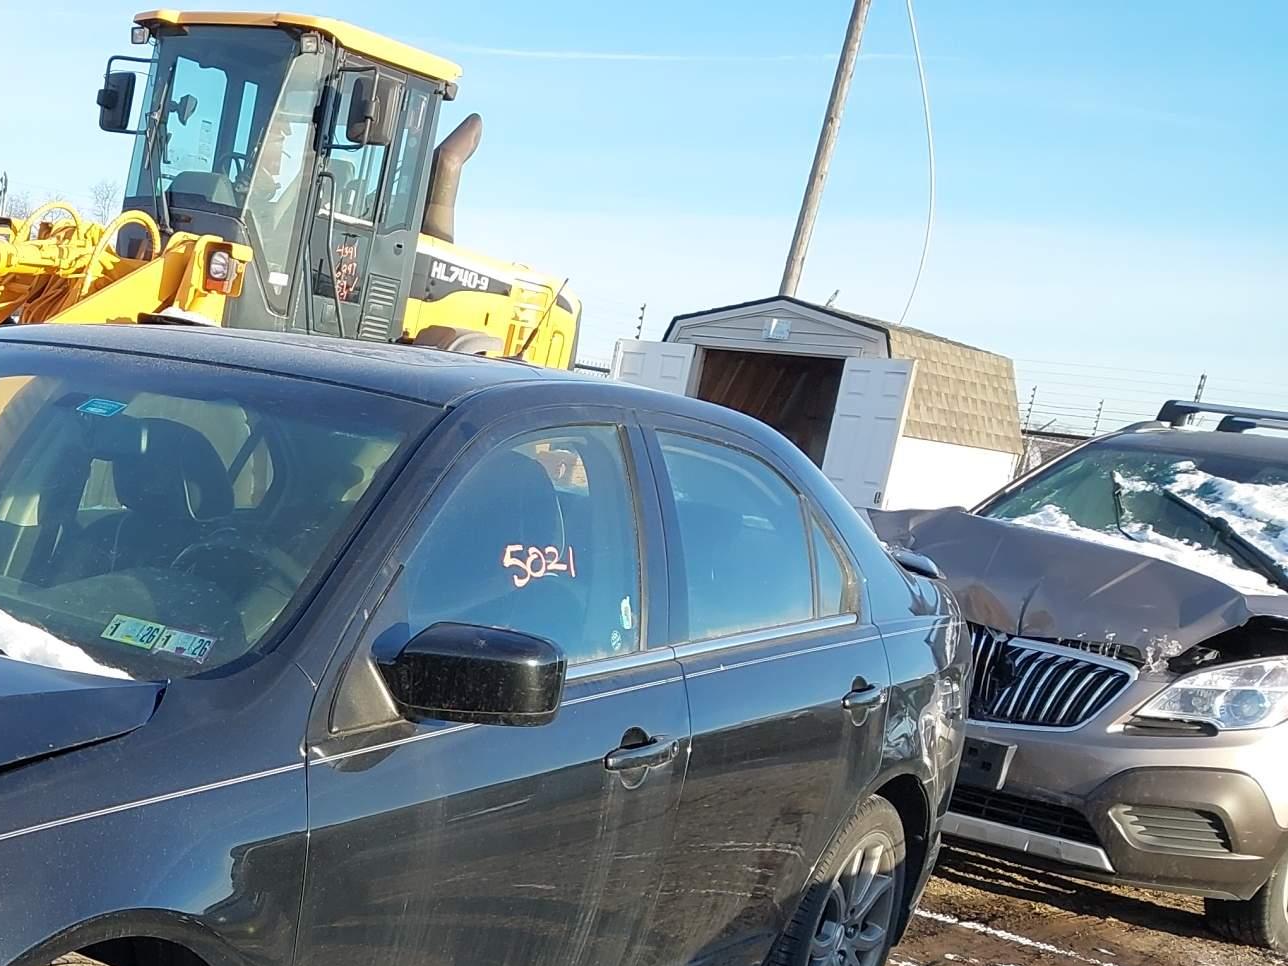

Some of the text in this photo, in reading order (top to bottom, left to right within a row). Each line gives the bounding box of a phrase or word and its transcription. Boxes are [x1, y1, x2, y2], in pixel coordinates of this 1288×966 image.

[430, 260, 489, 291] HL740-9
[503, 544, 576, 588] 5021
[139, 626, 160, 644] 26
[191, 638, 212, 657] 26
